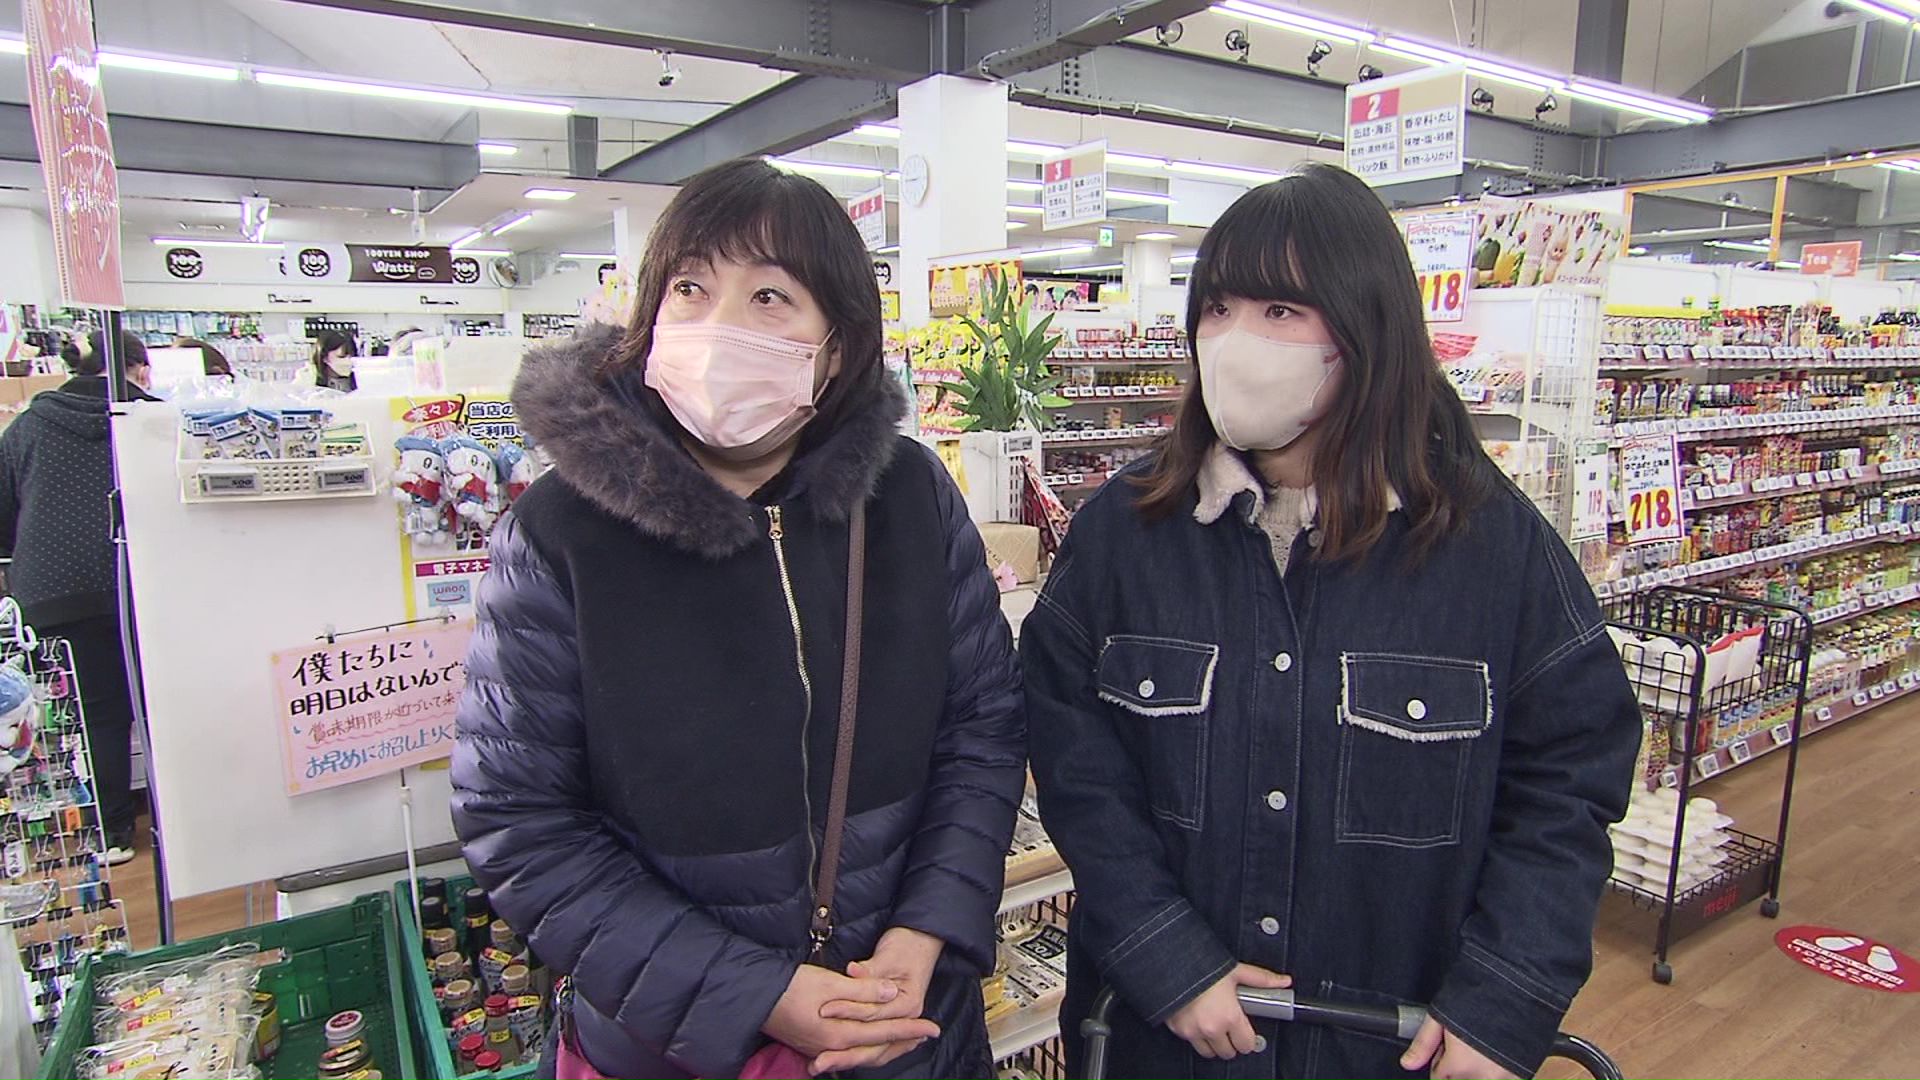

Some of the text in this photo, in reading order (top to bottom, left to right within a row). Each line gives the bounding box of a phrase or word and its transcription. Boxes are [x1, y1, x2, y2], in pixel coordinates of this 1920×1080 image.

[1367, 94, 1381, 120] 2
[1055, 162, 1063, 181] 3
[301, 253, 327, 265] 100
[403, 250, 431, 259] SHOP
[1806, 253, 1829, 265] Tea
[372, 260, 417, 273] Watts
[471, 404, 513, 416] 当店の
[1630, 489, 1671, 531] 218
[432, 560, 491, 575] 電子マネー
[292, 641, 414, 687] 僕たちに
[308, 689, 461, 744] 賞味期限が近づいて来
[1703, 885, 1737, 918] meiji
